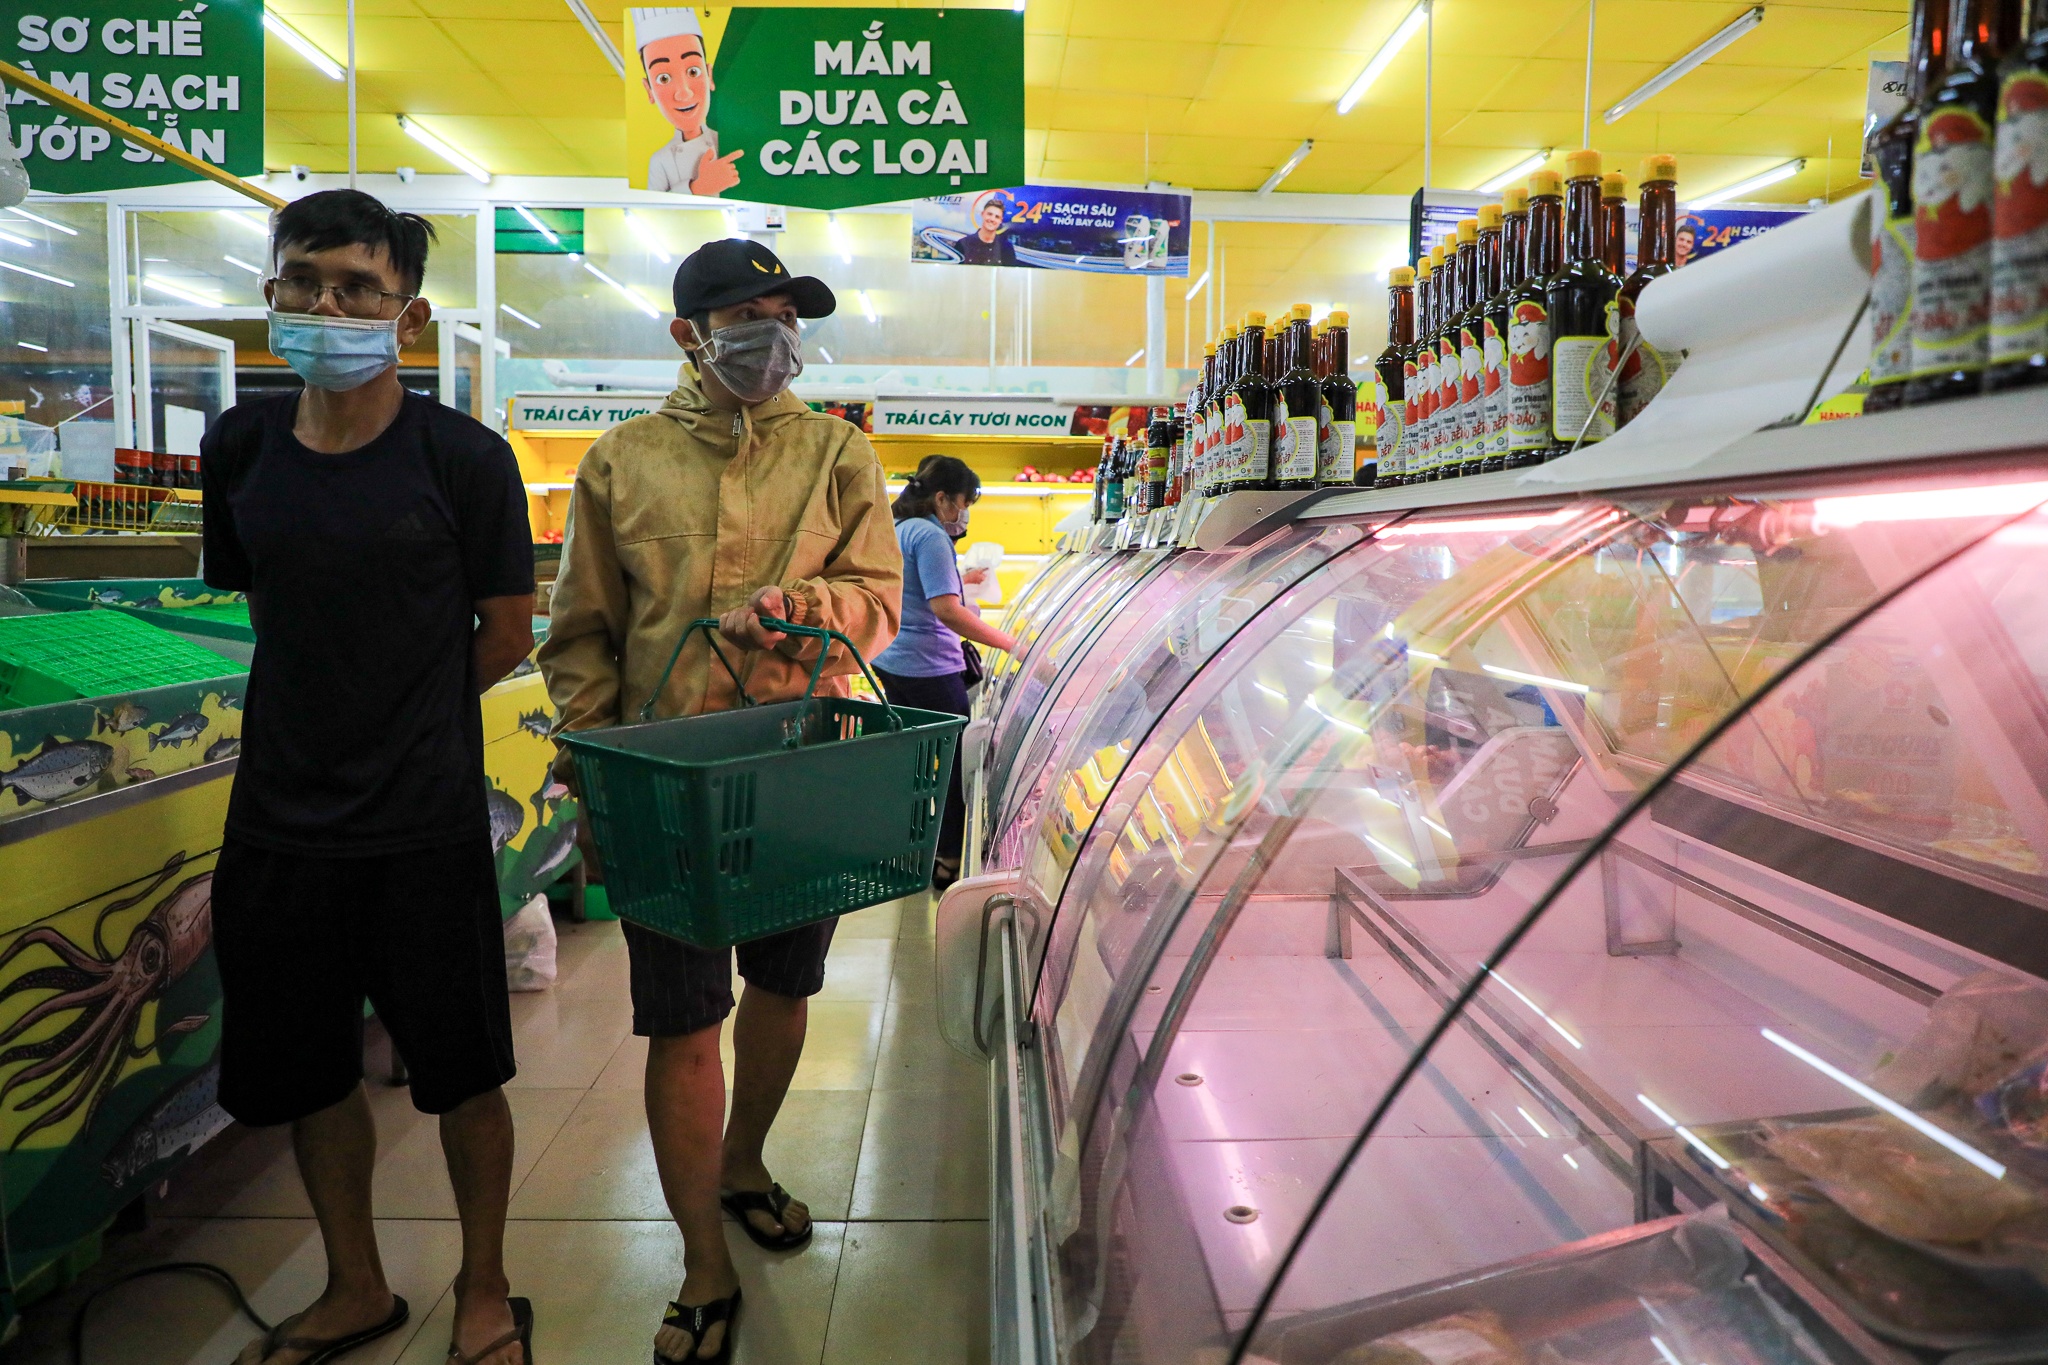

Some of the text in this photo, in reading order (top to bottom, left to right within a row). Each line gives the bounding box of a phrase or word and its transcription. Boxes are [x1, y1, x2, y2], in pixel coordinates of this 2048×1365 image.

[17, 2, 209, 56] SƠ CHẾ
[813, 20, 931, 76] MẮM
[101, 72, 240, 121] SẠCH
[779, 80, 969, 126] DƯA CÀ
[759, 129, 988, 187] CÁC LOẠI
[1090, 203, 1117, 217] SÂU
[523, 405, 565, 422] TRÁI
[570, 405, 604, 422] CÂY
[884, 408, 1068, 428] TRÁI CÂY TƯƠI NGON
